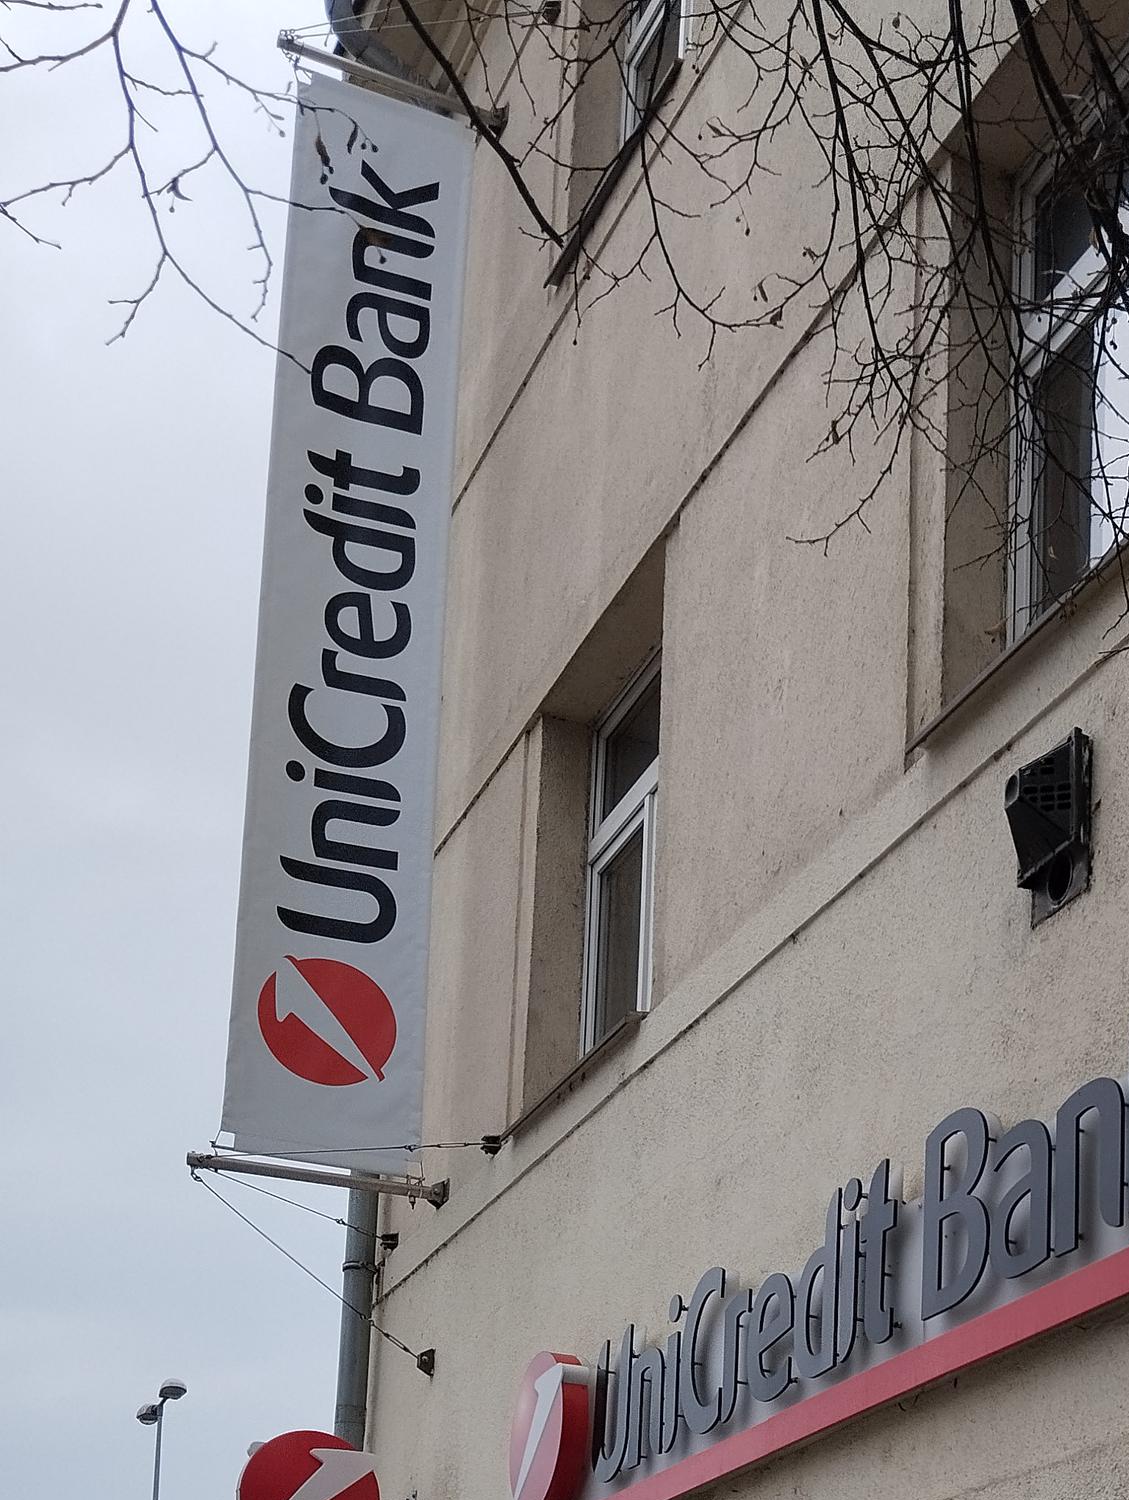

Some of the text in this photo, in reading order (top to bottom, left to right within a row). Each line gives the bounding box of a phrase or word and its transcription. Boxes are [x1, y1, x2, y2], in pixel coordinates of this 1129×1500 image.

[276, 158, 440, 945] UniCredit Bank
[592, 1158, 899, 1484] UniCredit
